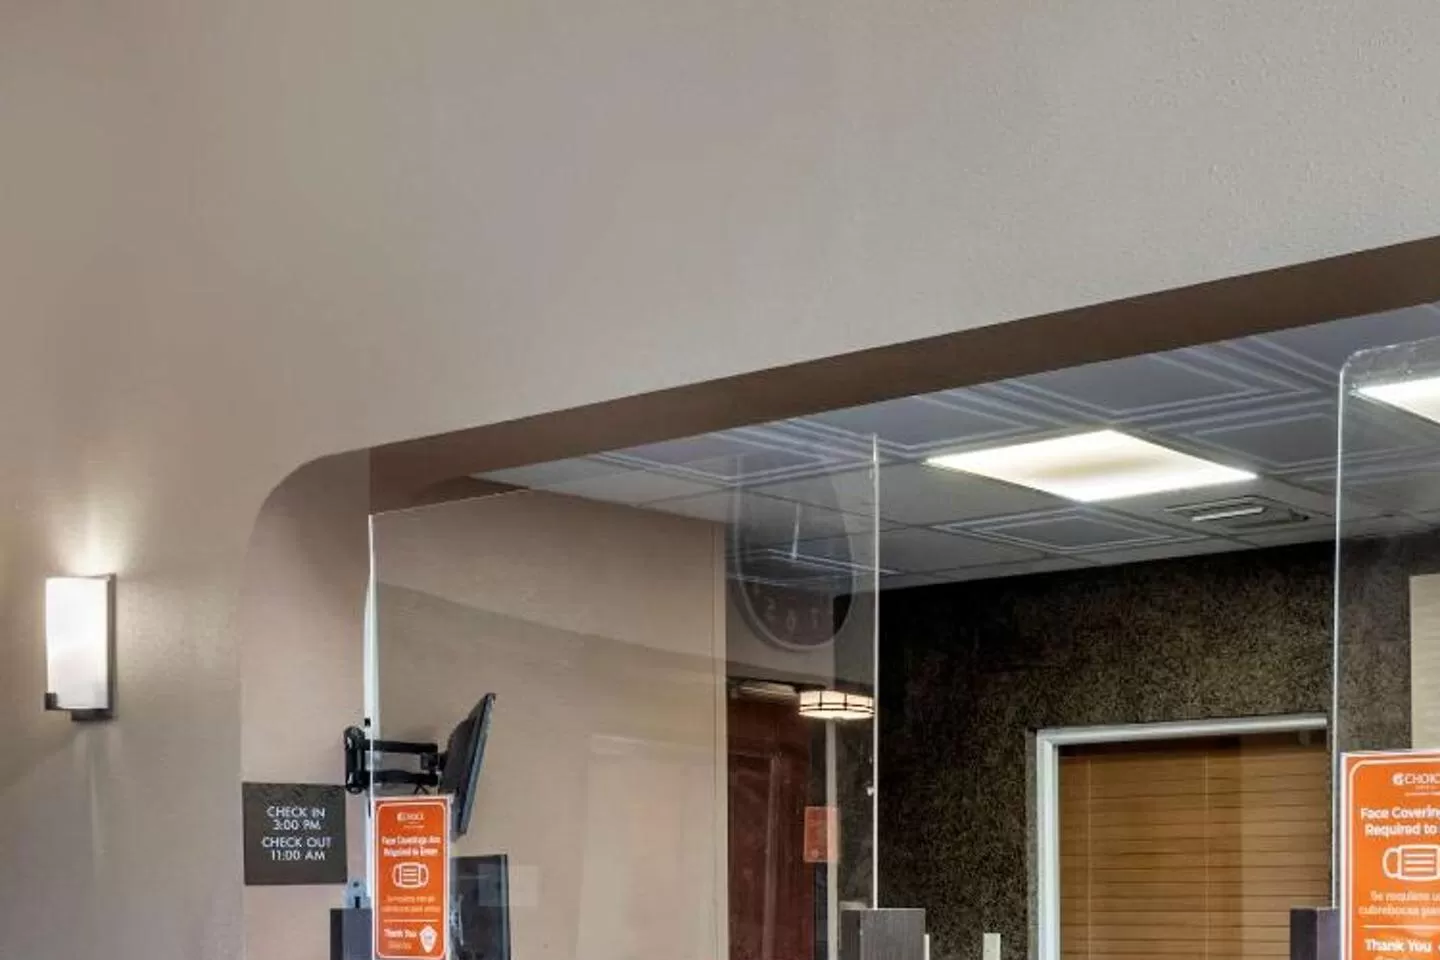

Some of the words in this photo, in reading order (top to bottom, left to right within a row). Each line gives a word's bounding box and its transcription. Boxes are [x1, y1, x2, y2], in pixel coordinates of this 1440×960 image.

[266, 806, 308, 818] CHECK
[311, 807, 326, 818] IN
[1360, 807, 1390, 819] Face
[303, 819, 322, 830] PM
[1364, 823, 1421, 838] Required
[1423, 823, 1438, 835] to
[261, 836, 303, 848] CHECK
[306, 837, 332, 848] OUT
[304, 850, 326, 860] AM
[1364, 937, 1405, 952] Thank
[1407, 939, 1432, 953] You
